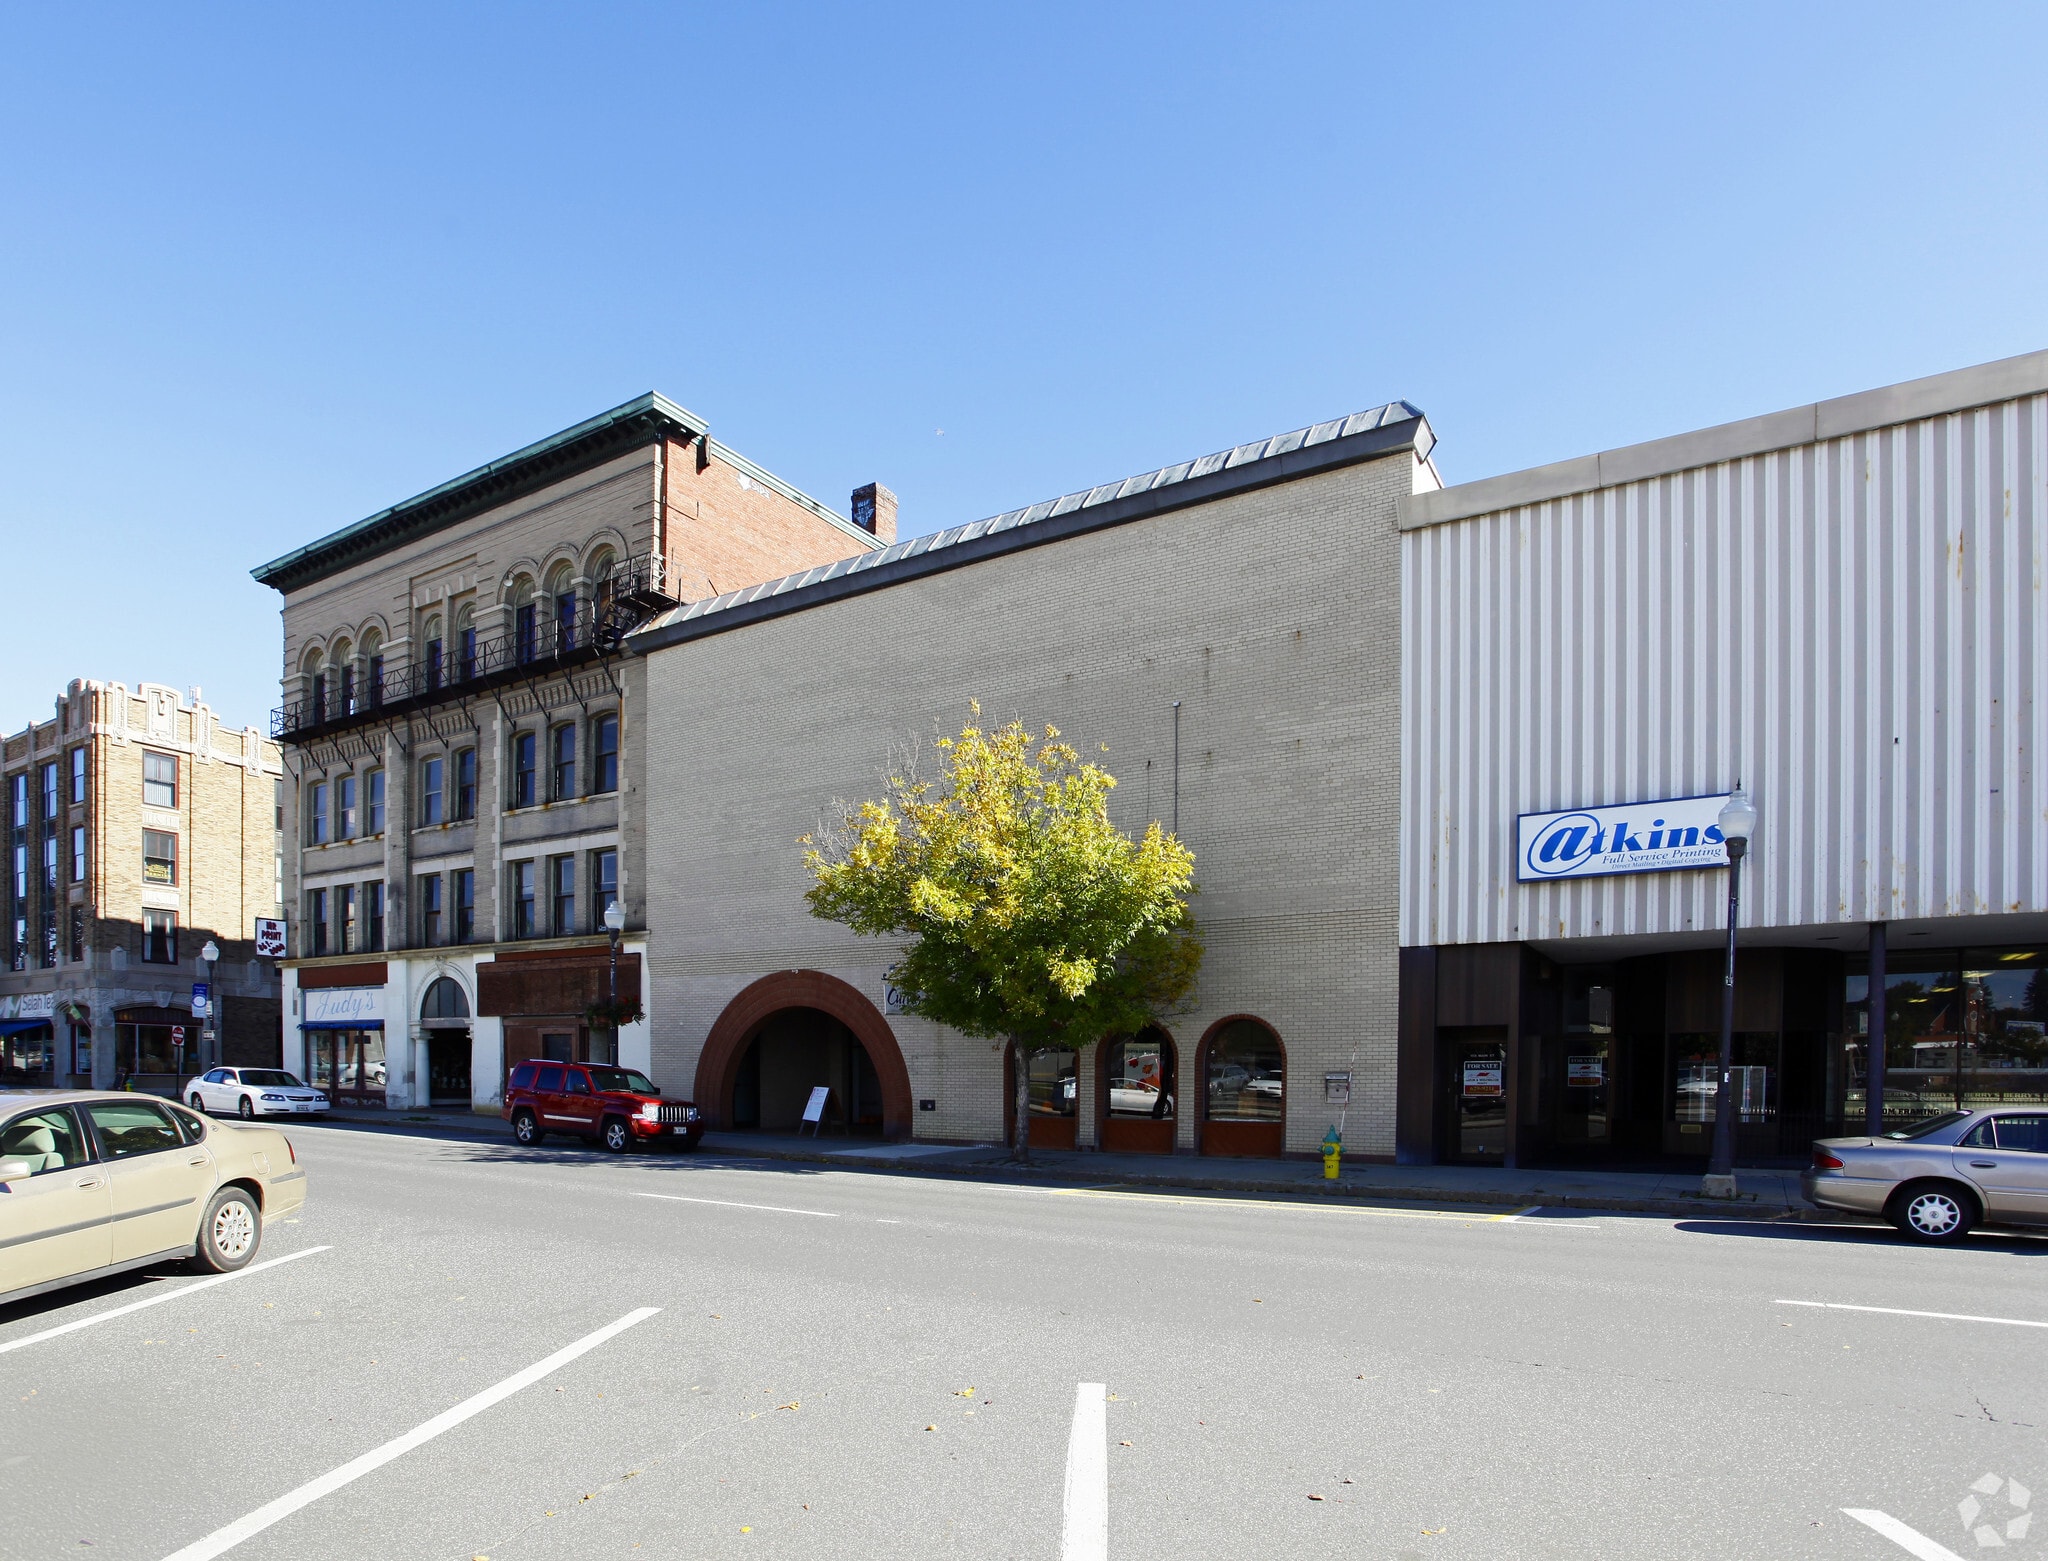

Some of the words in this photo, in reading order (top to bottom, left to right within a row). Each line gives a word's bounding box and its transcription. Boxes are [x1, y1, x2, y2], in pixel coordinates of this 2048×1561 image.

[1602, 853, 1626, 864] Full
[1627, 851, 1669, 862] Service
[1672, 847, 1722, 859] Printing
[1632, 860, 1656, 869] Mailing
[1661, 858, 1684, 866] Digital
[1684, 855, 1712, 864] Copying
[261, 930, 282, 941] PRINT
[315, 990, 376, 1020] Judy's
